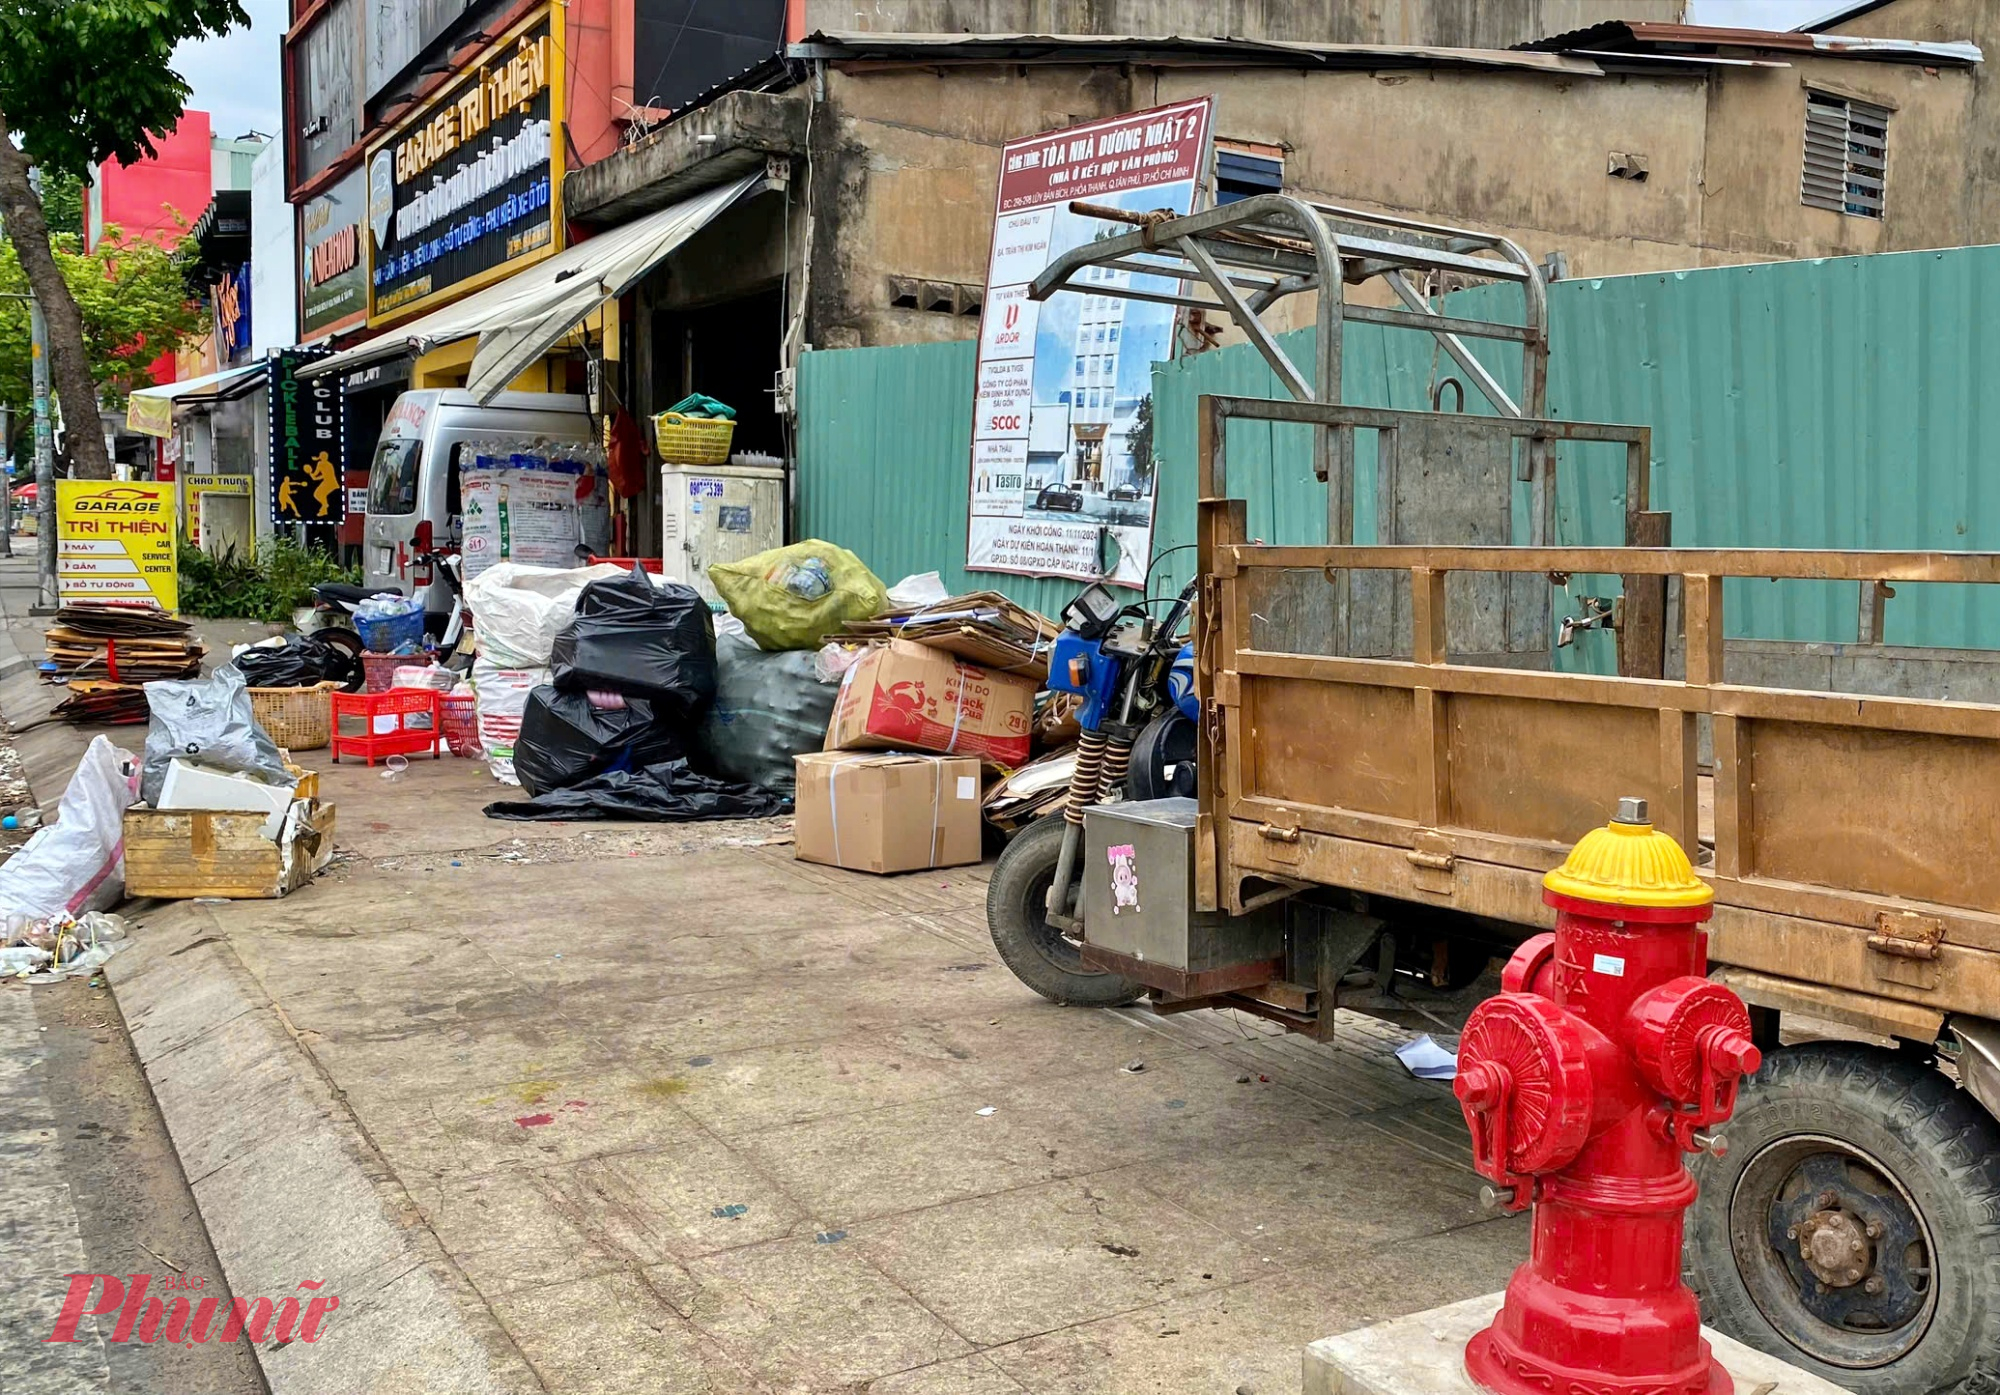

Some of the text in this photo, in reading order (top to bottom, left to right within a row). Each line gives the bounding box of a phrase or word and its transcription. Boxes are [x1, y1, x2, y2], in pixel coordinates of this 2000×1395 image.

[396, 36, 550, 185] GARAGE TRÍ THIỆN
[1042, 142, 1065, 168] TÒA
[1069, 134, 1094, 163] NHÀ
[1098, 127, 1142, 157] DƯƠNG
[1144, 116, 1184, 148] NHẬT
[1186, 115, 1197, 139] 2
[1049, 149, 1179, 186] (NHÀ Ở KẾT HỢP VĂN PHÒNG)
[1172, 166, 1189, 178] MINH
[518, 191, 529, 217] XE
[995, 332, 1020, 344] ARDOR
[280, 357, 333, 471] PICKLEBALL CLUB
[991, 415, 1021, 430] SCQC
[75, 501, 161, 511] GARAGE
[66, 519, 167, 536] TRÍ THIỆN
[1008, 523, 1025, 534] NGÀY
[142, 553, 171, 561] SERVICE
[144, 565, 171, 573] CENTER
[975, 685, 990, 697] DO
